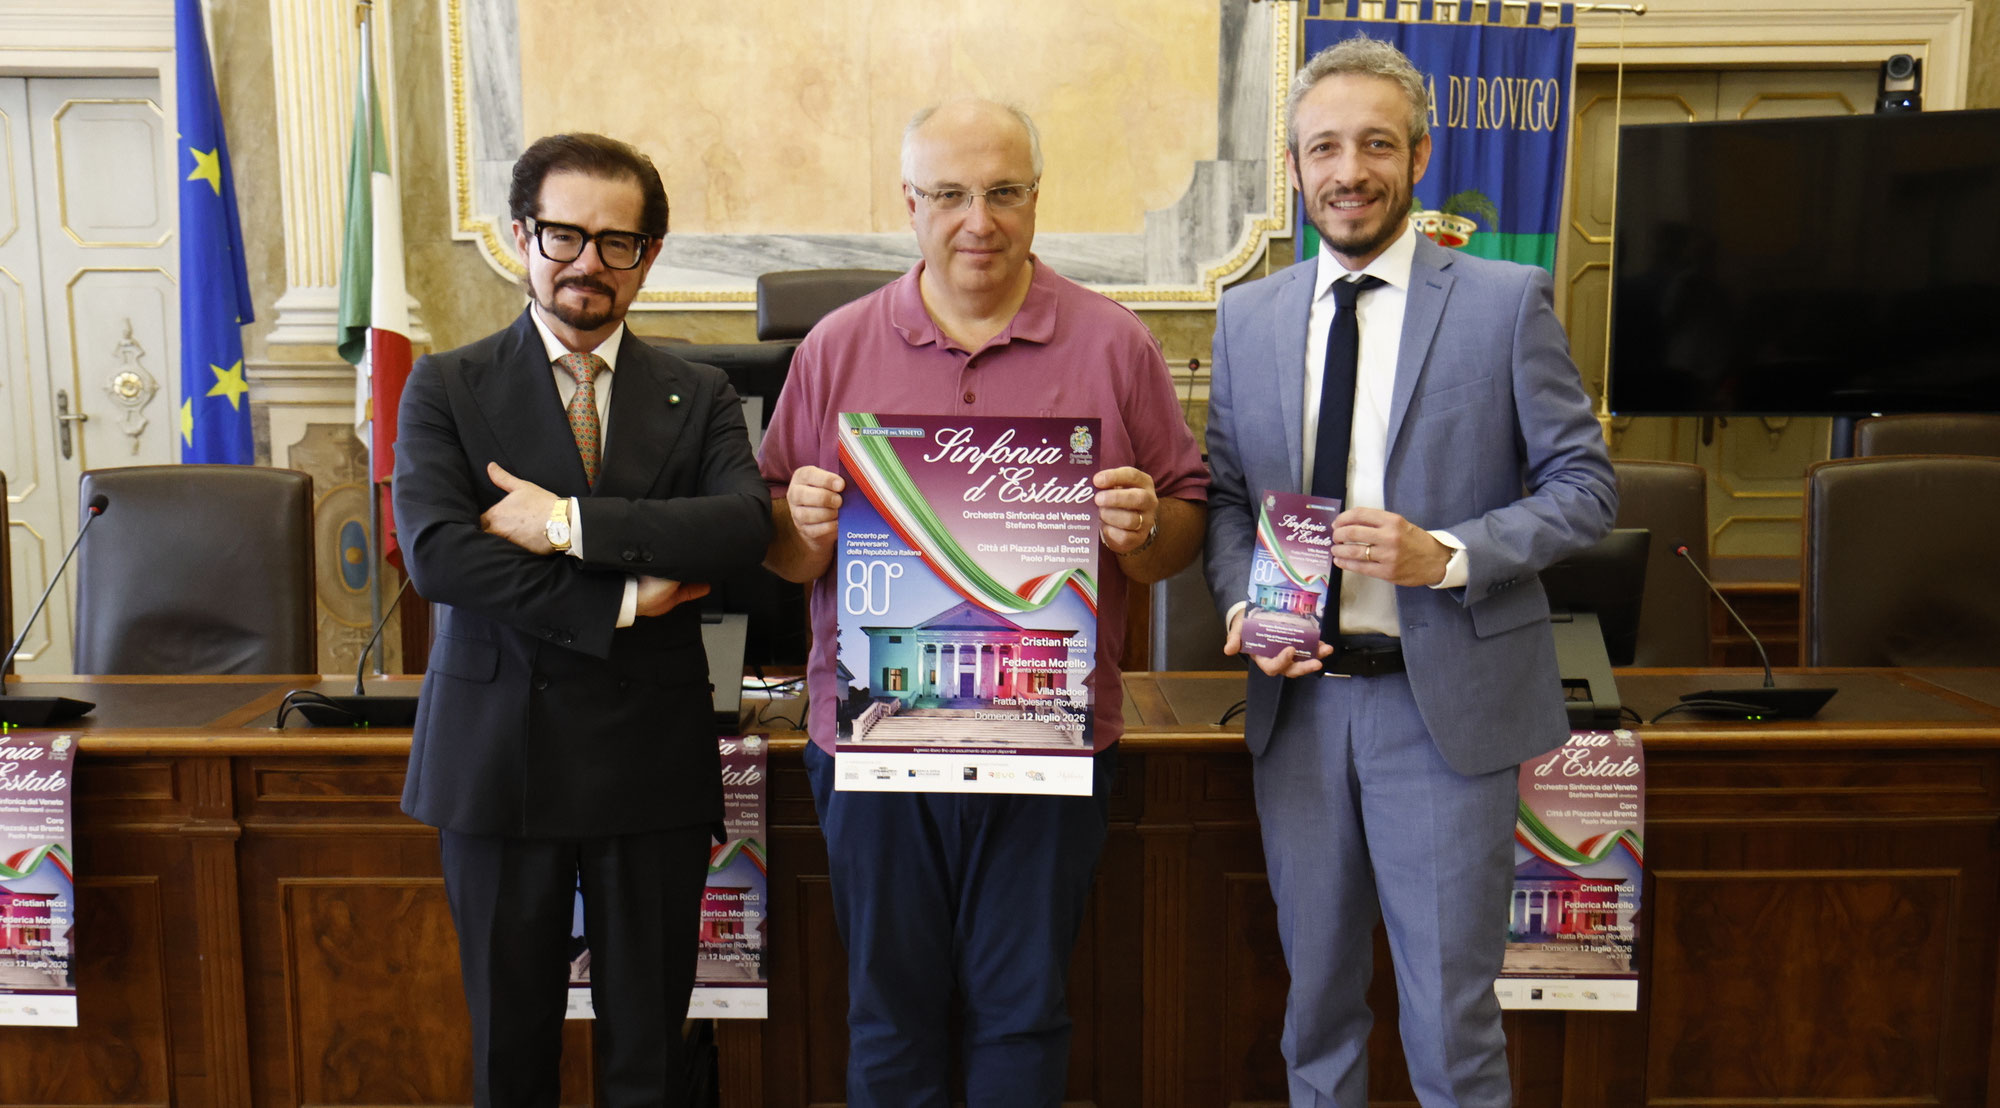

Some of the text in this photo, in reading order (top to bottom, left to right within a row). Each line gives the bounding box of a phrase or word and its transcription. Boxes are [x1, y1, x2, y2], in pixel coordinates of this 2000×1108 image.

[1448, 76, 1470, 129] DI
[1476, 77, 1560, 132] ROVIGO
[924, 426, 1063, 475] Sinfonia
[963, 468, 1095, 504] d'Estate
[962, 510, 1091, 521] Orchestra Sinfonica del Veneto
[1005, 522, 1036, 530] Stefano
[1037, 522, 1066, 530] Romani
[1278, 514, 1327, 533] Sinfonia
[1068, 536, 1090, 544] Coro
[978, 544, 1090, 554] Città di Piazzola sul Brenta
[1021, 555, 1043, 563] Paolo
[1044, 555, 1065, 563] Piana
[846, 560, 904, 616] 80°
[1022, 637, 1087, 648] Cristian Ricci
[1002, 657, 1087, 668] Federica Morello
[1037, 687, 1086, 696] Villa Badoer
[993, 698, 1017, 706] Fratta
[1018, 698, 1053, 707] Polesine
[975, 712, 1086, 723] Domenica 12 luglio 2026
[1534, 783, 1569, 791] Orchestra
[39, 798, 65, 806] Veneto
[1620, 802, 1638, 810] Coro
[46, 817, 65, 825] Coro
[1580, 884, 1635, 893] Cristian Ricci
[706, 893, 760, 901] Cristian Ricci
[12, 899, 67, 908] Cristian Ricci
[1565, 901, 1634, 909] Federica Morello
[728, 910, 760, 918] Morello
[35, 916, 67, 925] Morello
[1591, 945, 1612, 954] luglio
[719, 954, 740, 962] luglio
[16, 960, 26, 968] 12
[26, 960, 47, 970] luglio
[49, 961, 68, 969] 2026
